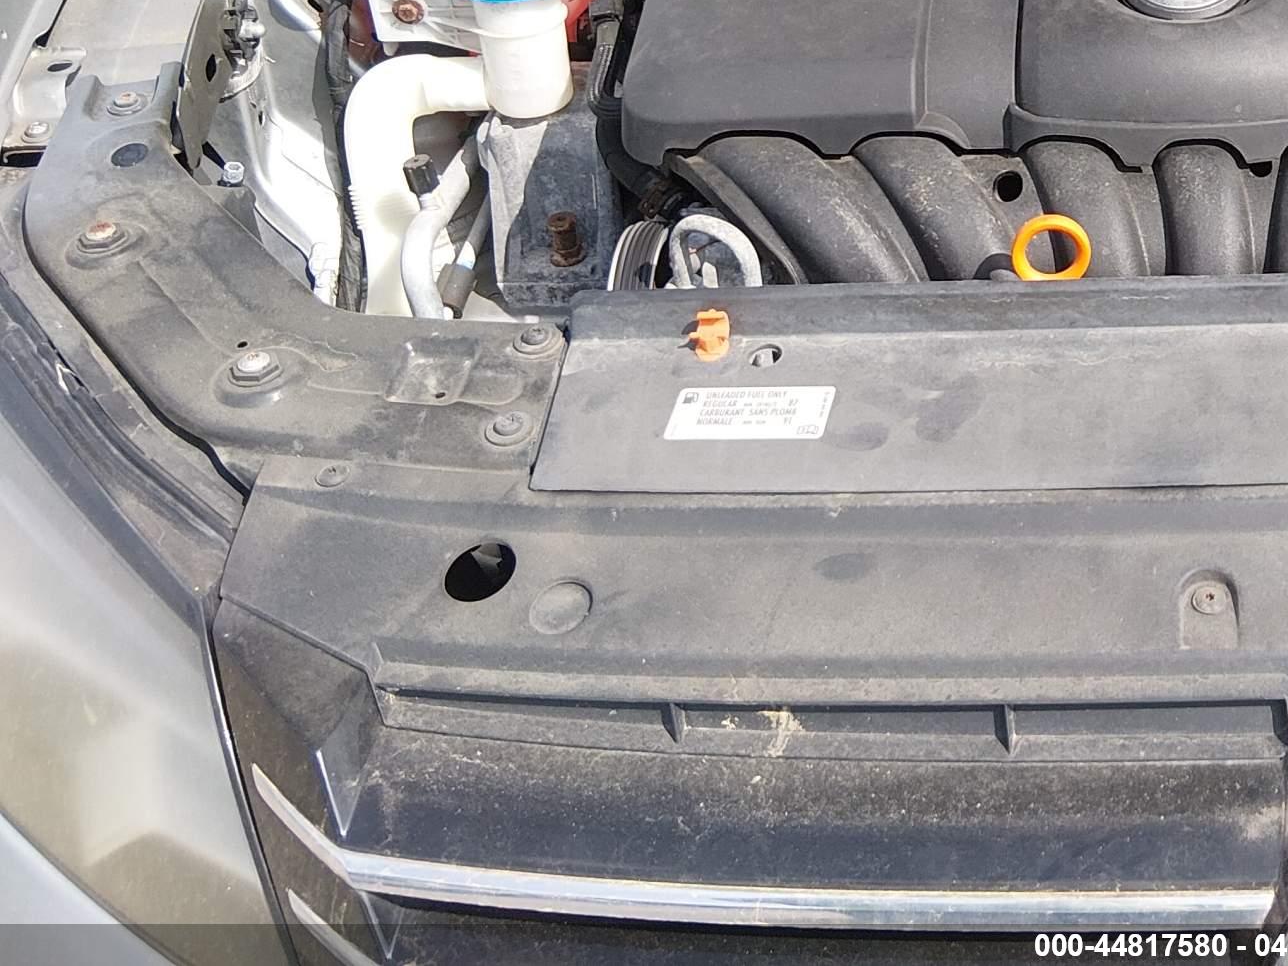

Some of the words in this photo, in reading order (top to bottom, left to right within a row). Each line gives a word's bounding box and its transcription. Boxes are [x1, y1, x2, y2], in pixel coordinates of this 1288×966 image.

[706, 391, 746, 399] UNLEADED
[747, 391, 765, 399] FUEL
[767, 390, 788, 398] ONLY
[703, 400, 738, 408] REGULAR
[748, 408, 769, 416] SANS
[769, 408, 797, 416] PLOMB
[696, 417, 733, 425] NORMALE
